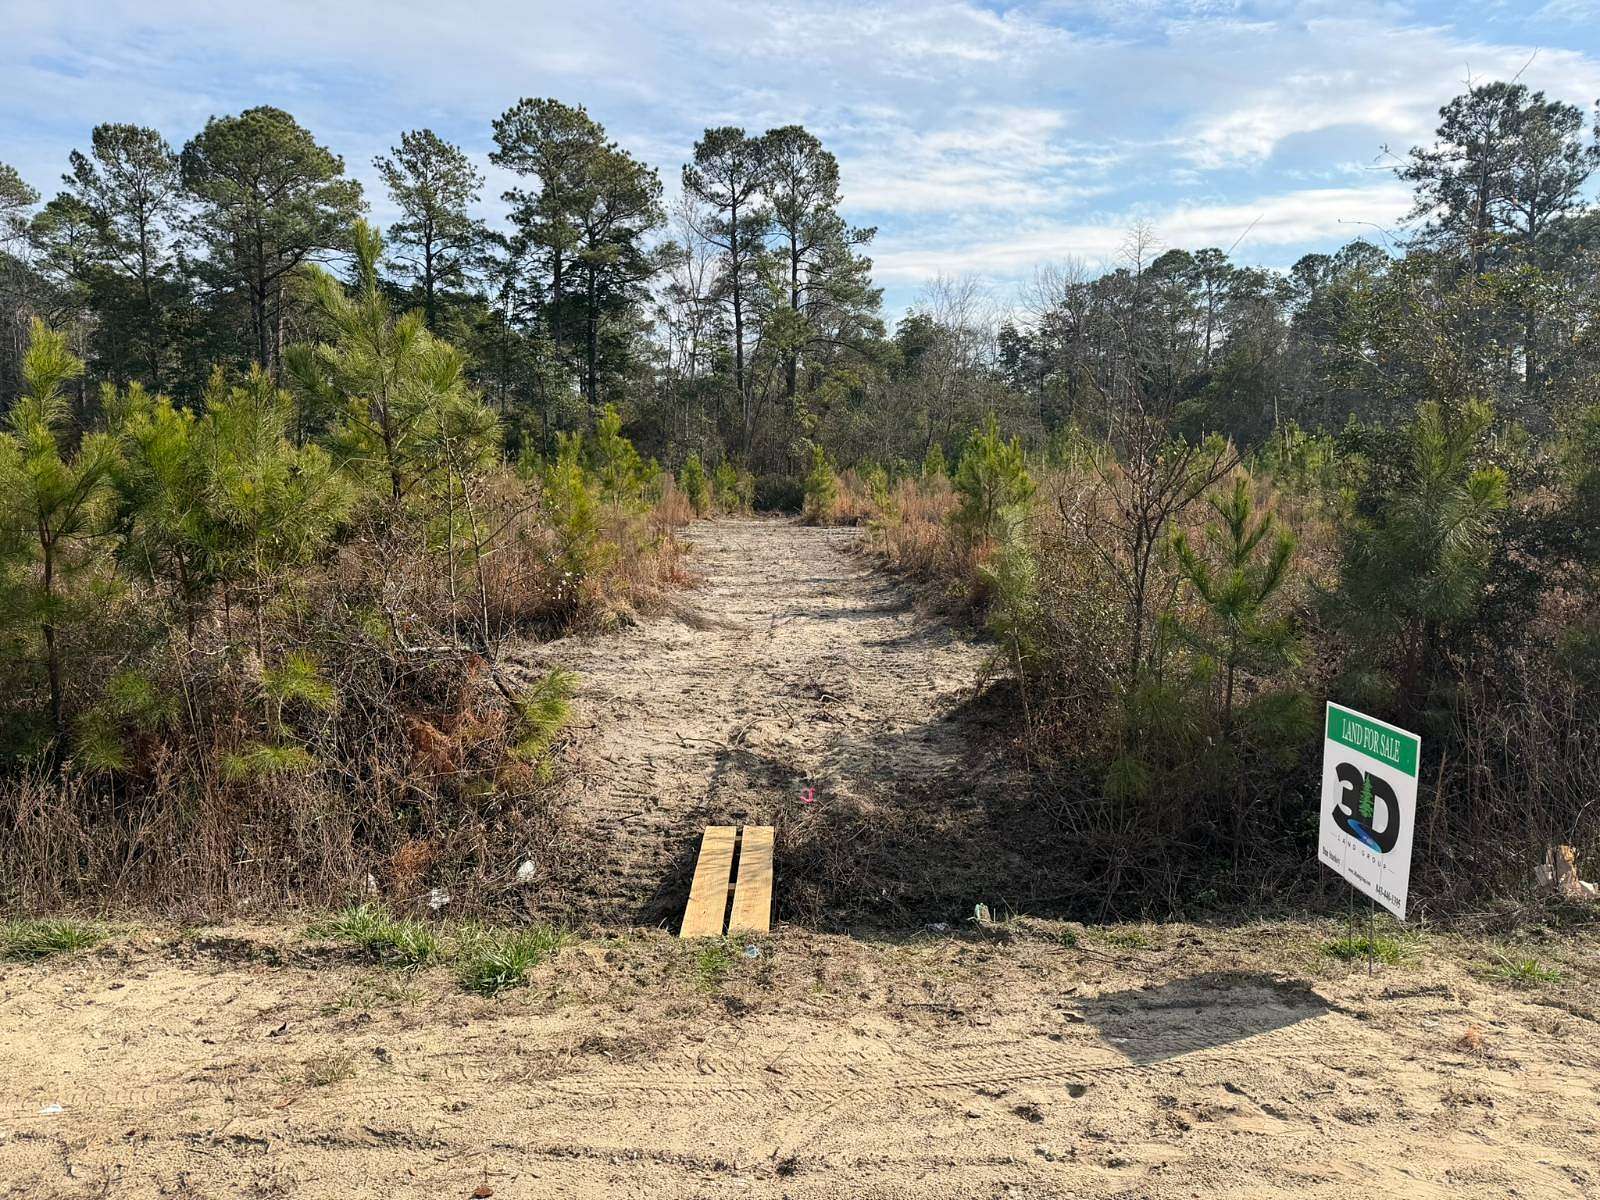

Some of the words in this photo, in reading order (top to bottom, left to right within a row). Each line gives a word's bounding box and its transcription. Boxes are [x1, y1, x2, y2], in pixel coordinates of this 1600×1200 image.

[1342, 718, 1362, 745] LAND
[1363, 727, 1379, 753] FOR
[1380, 734, 1400, 762] SALE
[1332, 762, 1400, 853] 3D
[1337, 834, 1356, 850] LAND
[1361, 850, 1386, 869] GROUP
